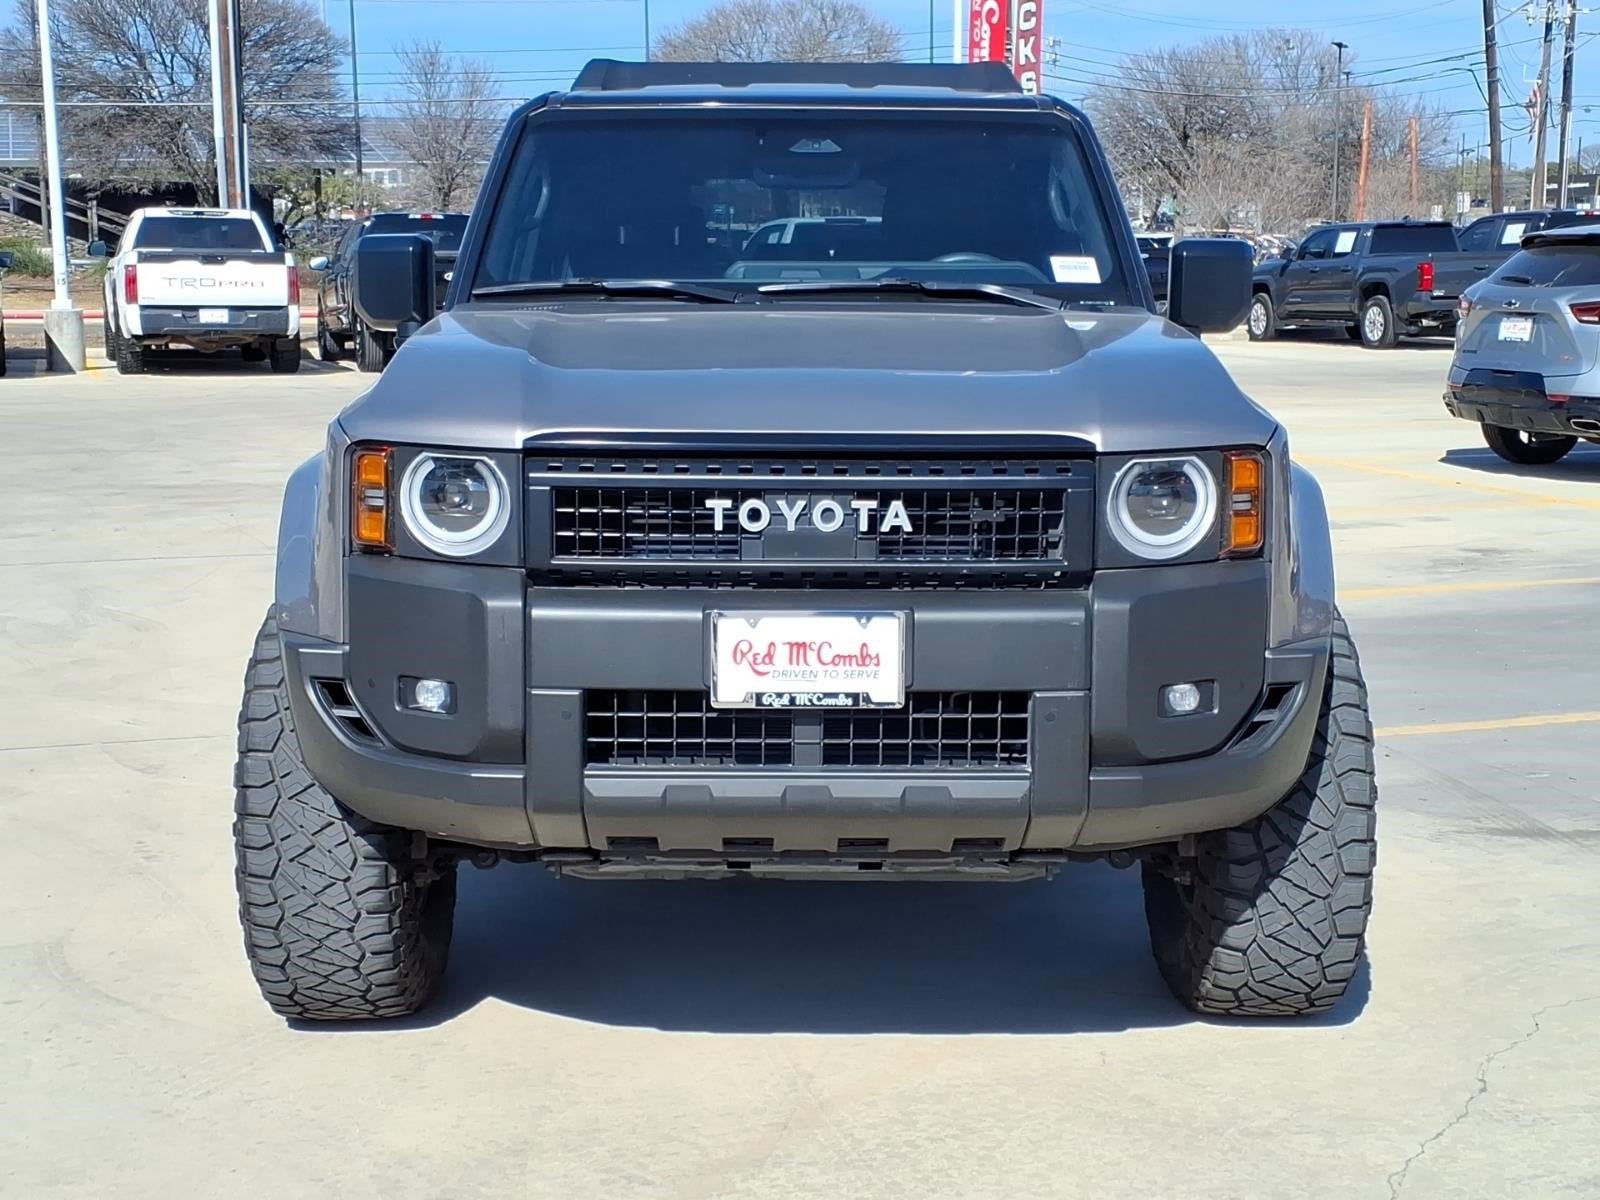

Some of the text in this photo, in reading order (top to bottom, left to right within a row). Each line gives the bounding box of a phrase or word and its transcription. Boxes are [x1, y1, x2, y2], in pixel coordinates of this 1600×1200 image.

[161, 276, 265, 289] TRD PRO
[705, 498, 913, 533] TOYOTA
[732, 639, 881, 677] Red McCombs
[771, 669, 880, 679] DRIVEN TO SERVE
[761, 692, 853, 708] Red McCombs
